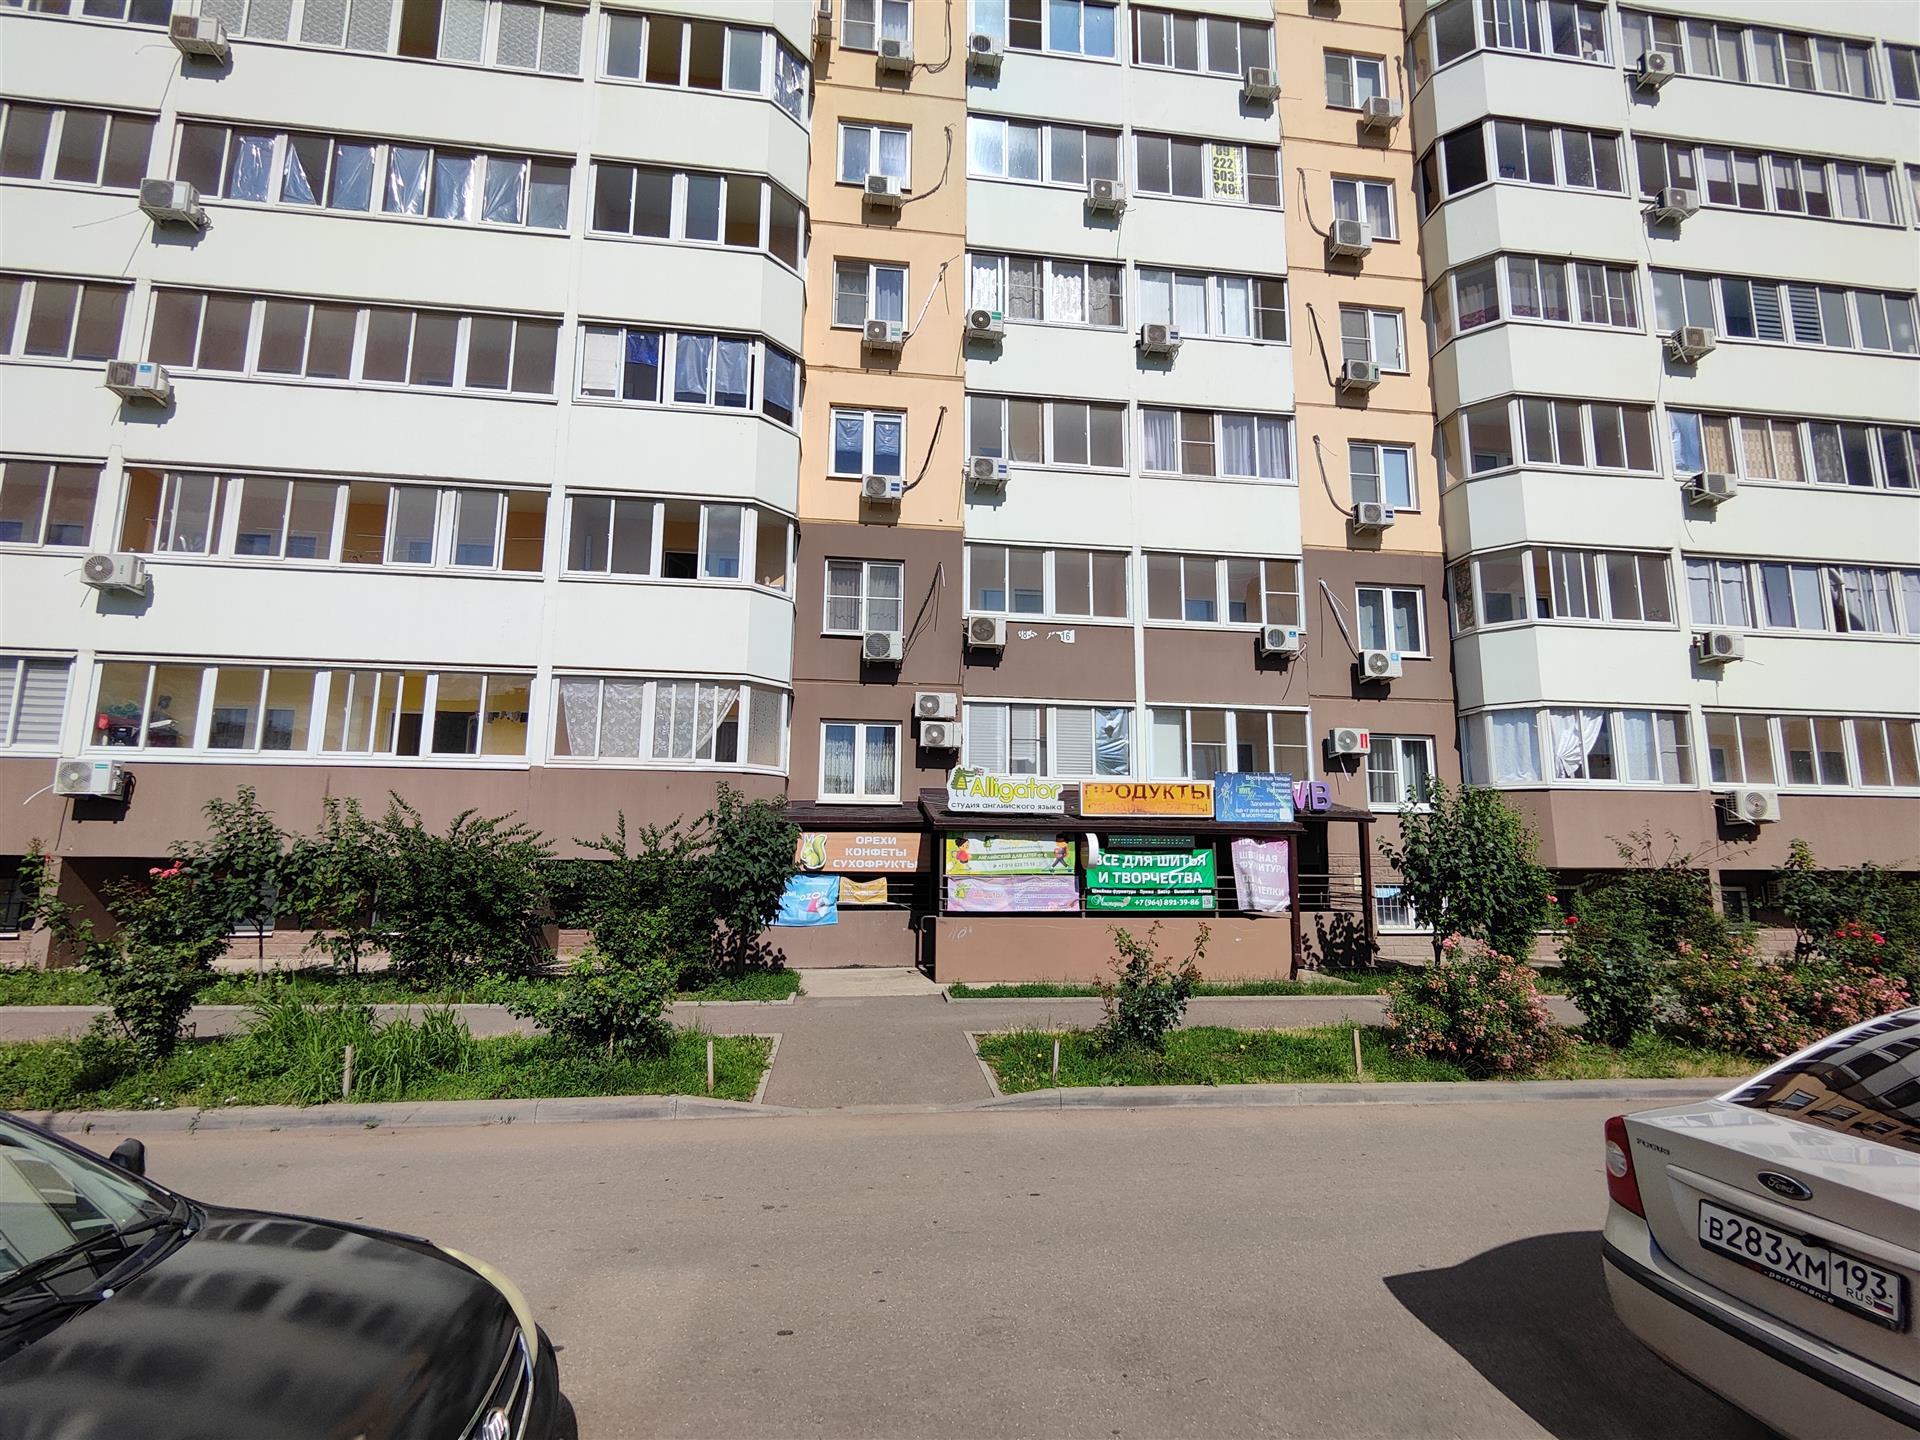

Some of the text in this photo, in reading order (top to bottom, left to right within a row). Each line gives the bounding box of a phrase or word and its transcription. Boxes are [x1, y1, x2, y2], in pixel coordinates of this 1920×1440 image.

[1213, 157, 1233, 169] 222
[1213, 169, 1235, 182] 503
[1214, 182, 1235, 194] 649
[970, 776, 1061, 804] Alligator
[982, 802, 1035, 810] английского
[855, 836, 897, 845] ОРЕХИ
[845, 848, 907, 857] КОНФЕТЫ
[832, 859, 918, 869] СУХОФРУКТЫ
[1096, 854, 1206, 869] ВСЕ ДЛЯ ШИТЬЯ
[1098, 871, 1203, 884] И ТВОРЧЕСТВА
[1144, 898, 1163, 907] (964)
[1163, 898, 1200, 906] 891-39-86
[1767, 1176, 1795, 1194] Ford
[1834, 1260, 1887, 1300] 193
[1846, 1287, 1874, 1306] RUS
